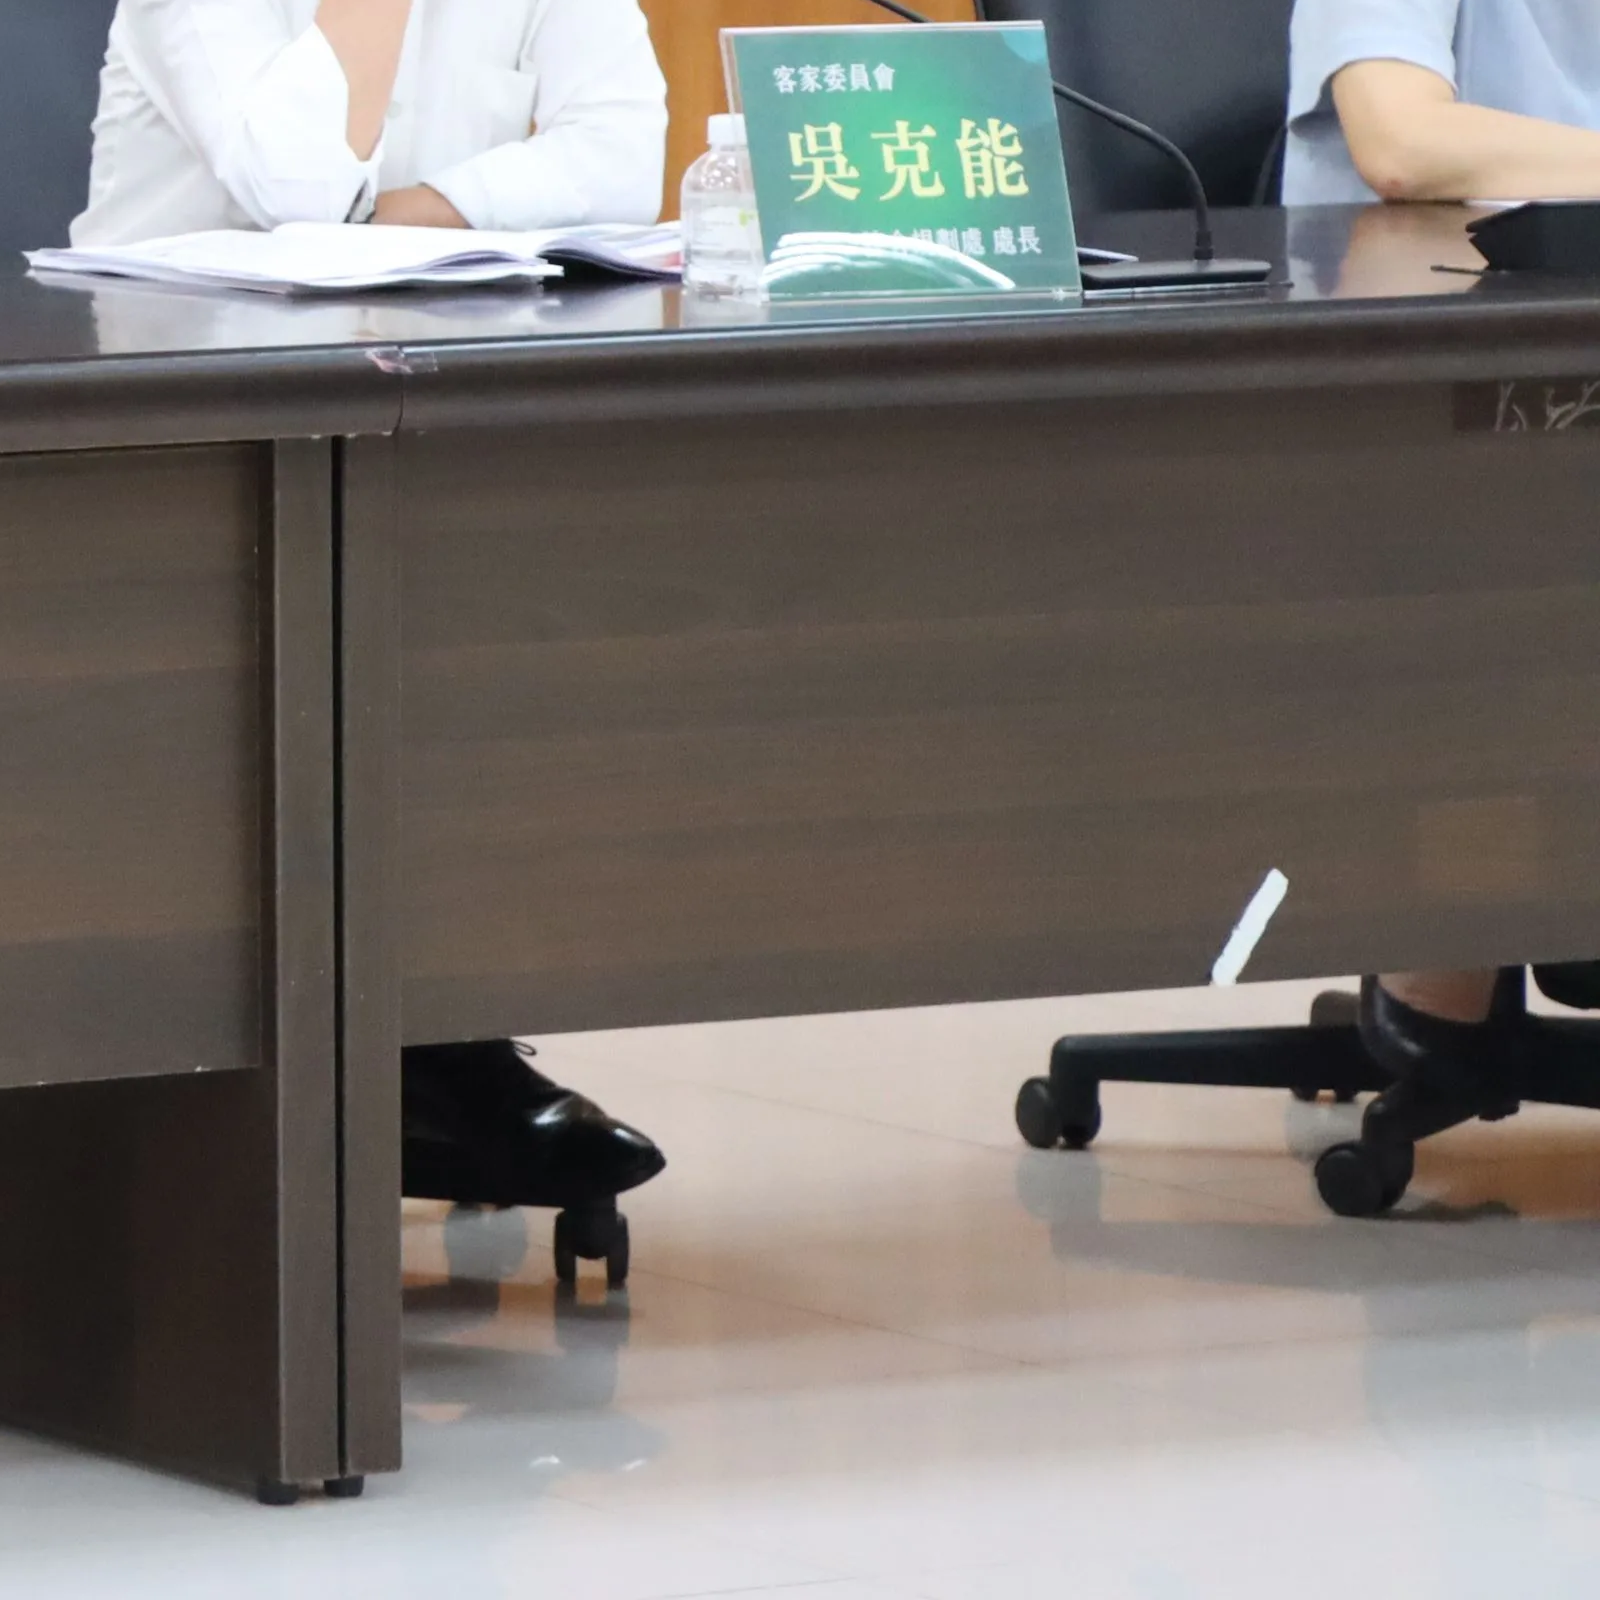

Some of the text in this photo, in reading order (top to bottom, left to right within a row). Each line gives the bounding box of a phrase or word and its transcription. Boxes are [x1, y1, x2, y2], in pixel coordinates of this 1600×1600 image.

[773, 63, 896, 94] 客家委員會
[788, 118, 1030, 202] 吳克能
[993, 226, 1043, 255] 處長
